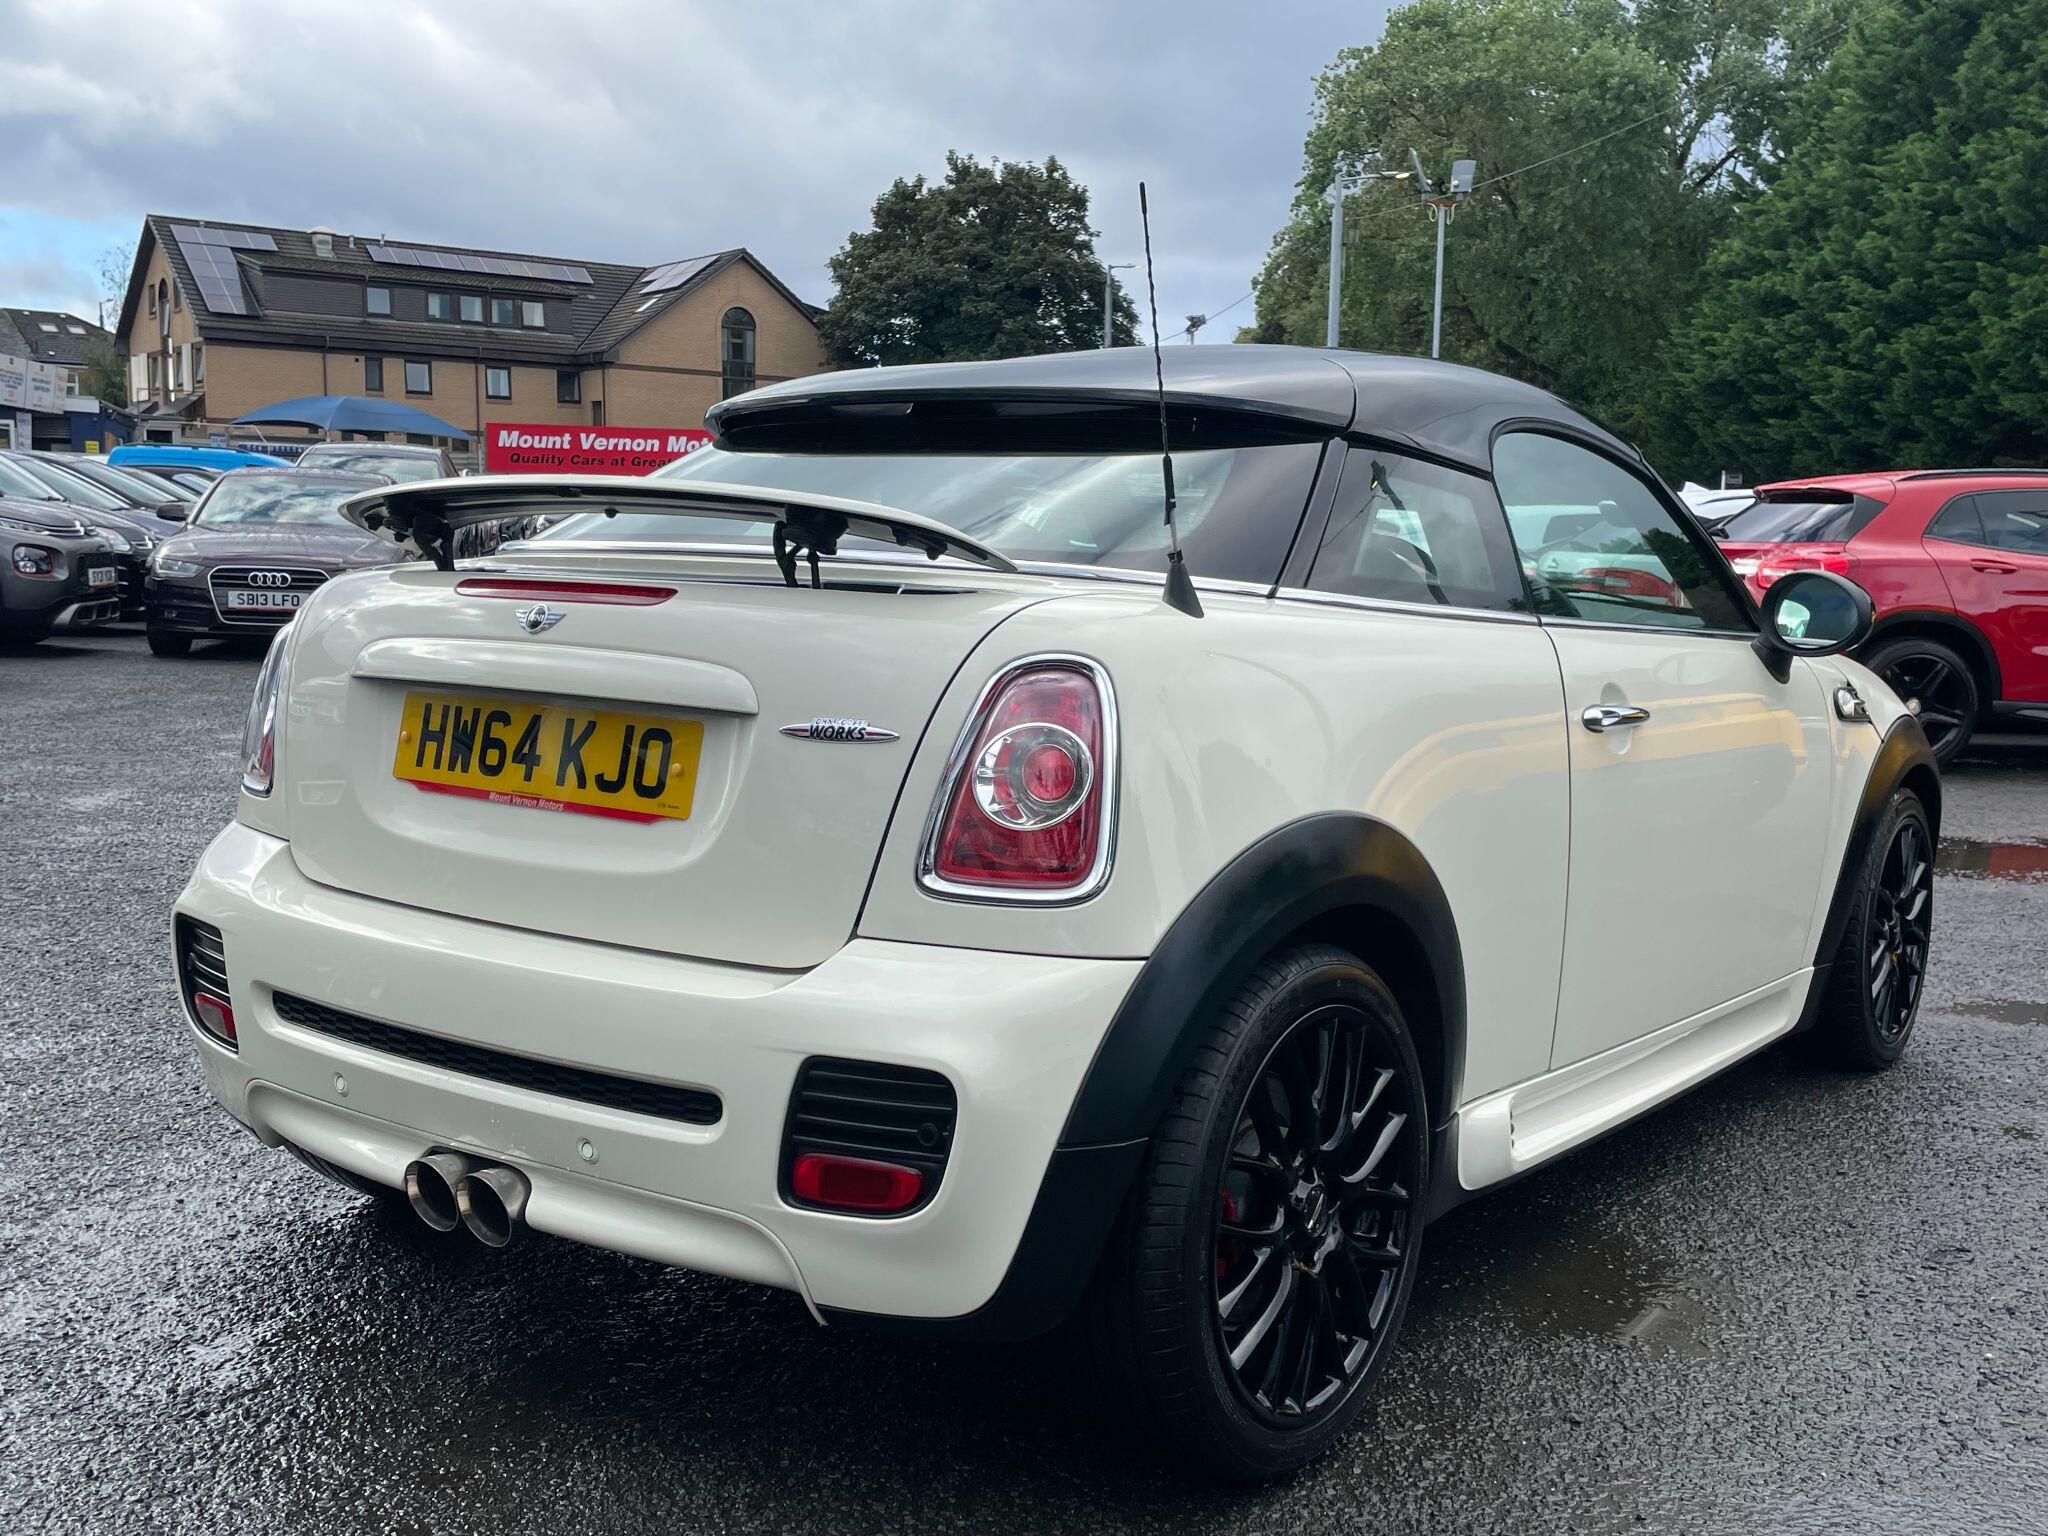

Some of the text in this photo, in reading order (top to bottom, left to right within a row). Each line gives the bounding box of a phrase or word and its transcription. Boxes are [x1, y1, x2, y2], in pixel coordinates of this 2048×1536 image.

[498, 430, 571, 449] Mount
[580, 432, 660, 452] Vernon
[510, 452, 565, 467] Quality
[570, 454, 605, 466] Cars
[610, 456, 626, 467] at
[809, 725, 867, 740] WORKS
[415, 702, 674, 800] HW64 KJO
[488, 791, 511, 804] Mount
[512, 796, 537, 808] Vernon
[538, 799, 565, 811] Motors
